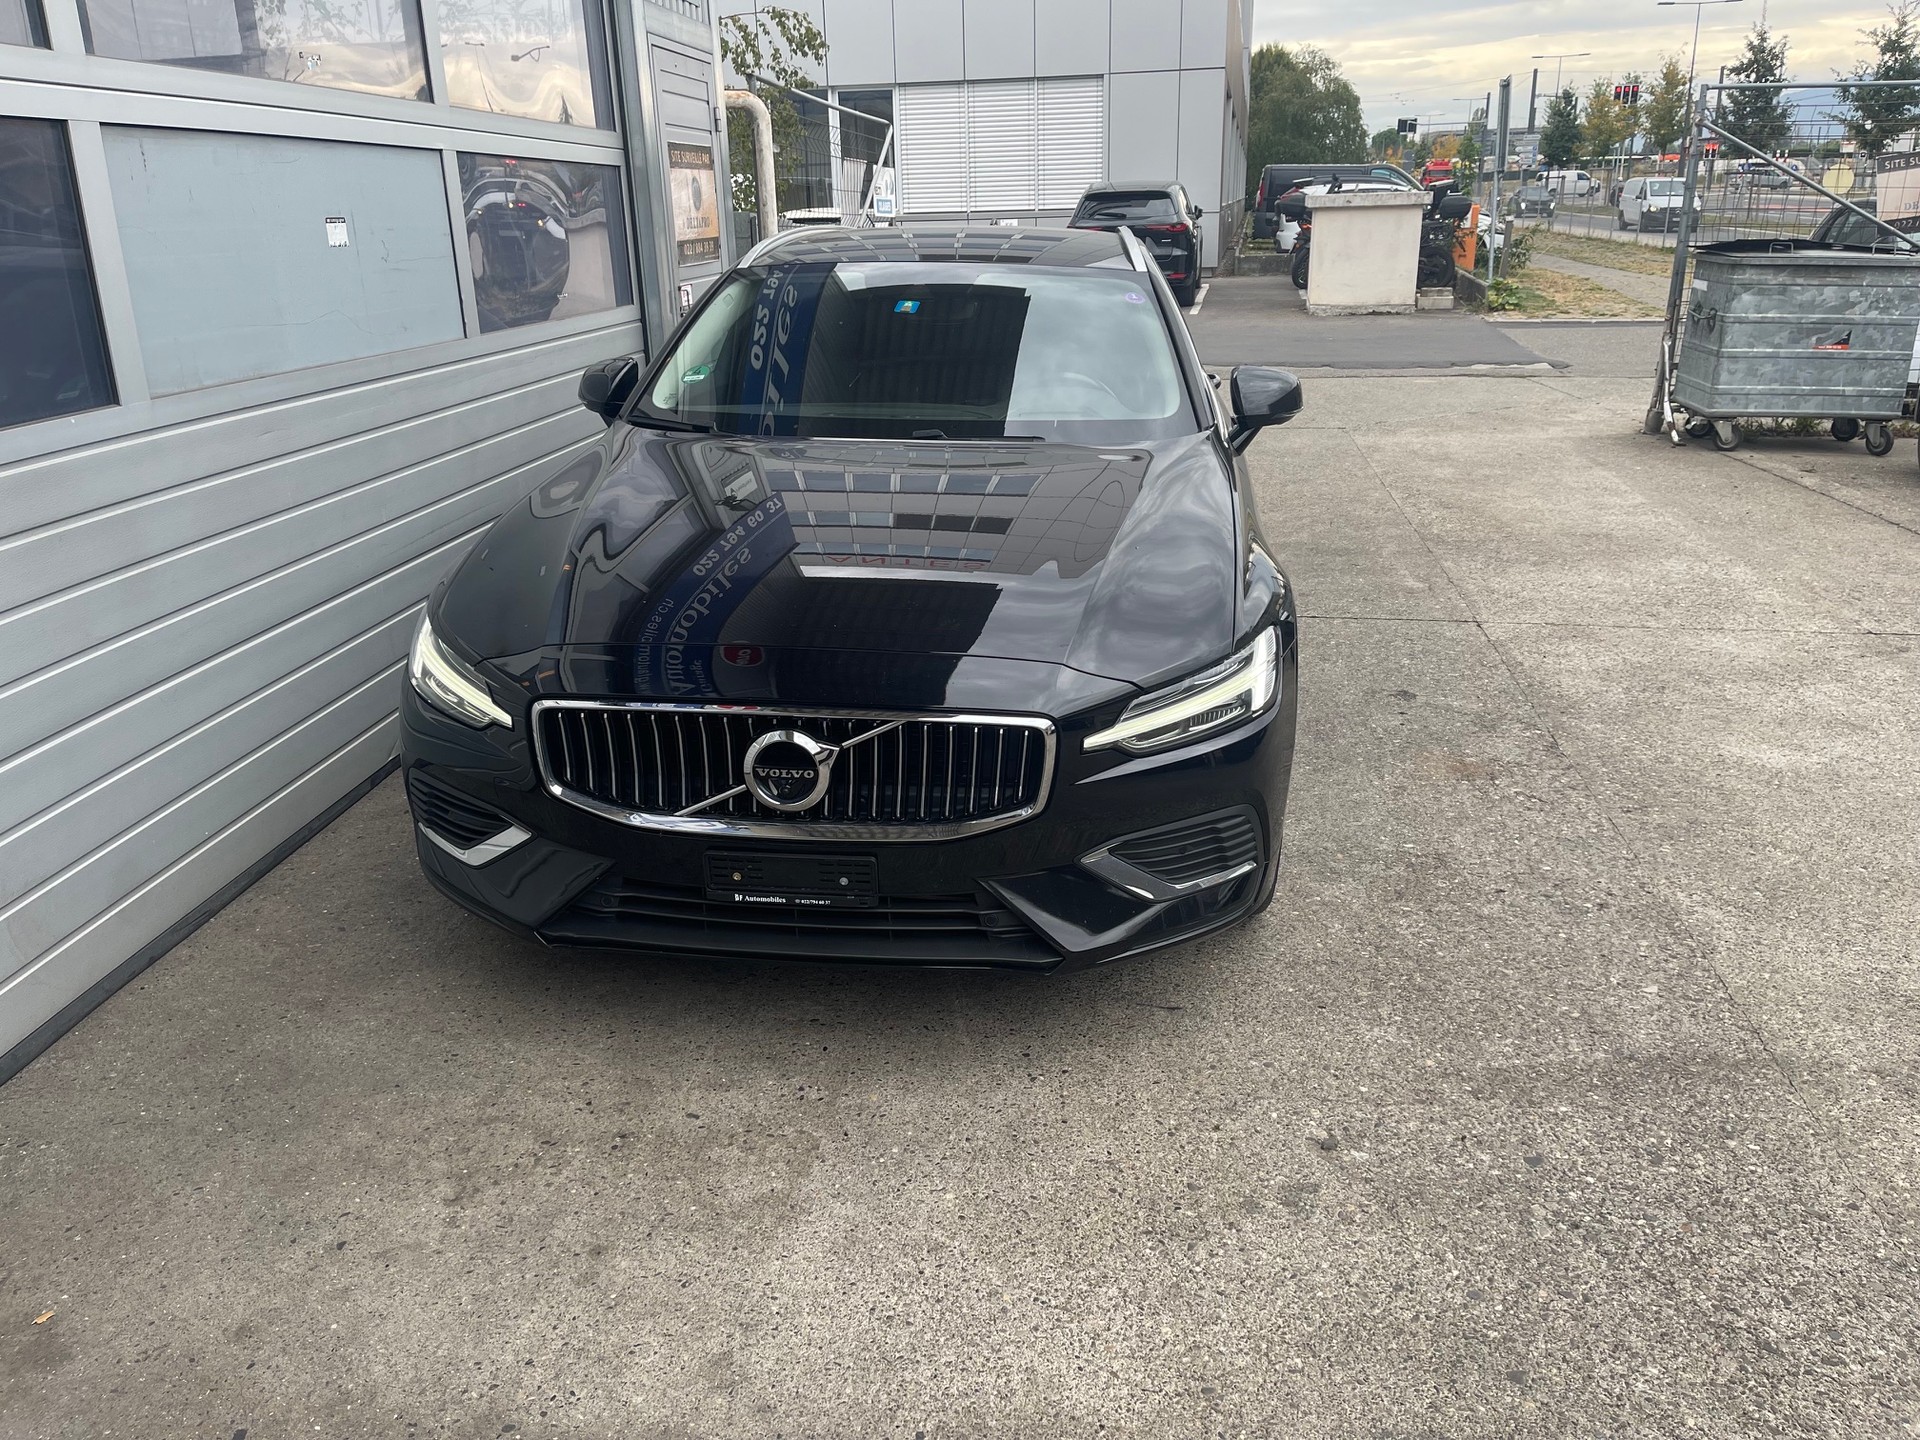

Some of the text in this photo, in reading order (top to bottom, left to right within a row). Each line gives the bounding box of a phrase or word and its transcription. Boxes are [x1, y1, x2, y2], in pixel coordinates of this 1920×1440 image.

[1885, 159, 1906, 169] SITE
[755, 767, 815, 778] VOLVO
[744, 895, 786, 903] Automobiles
